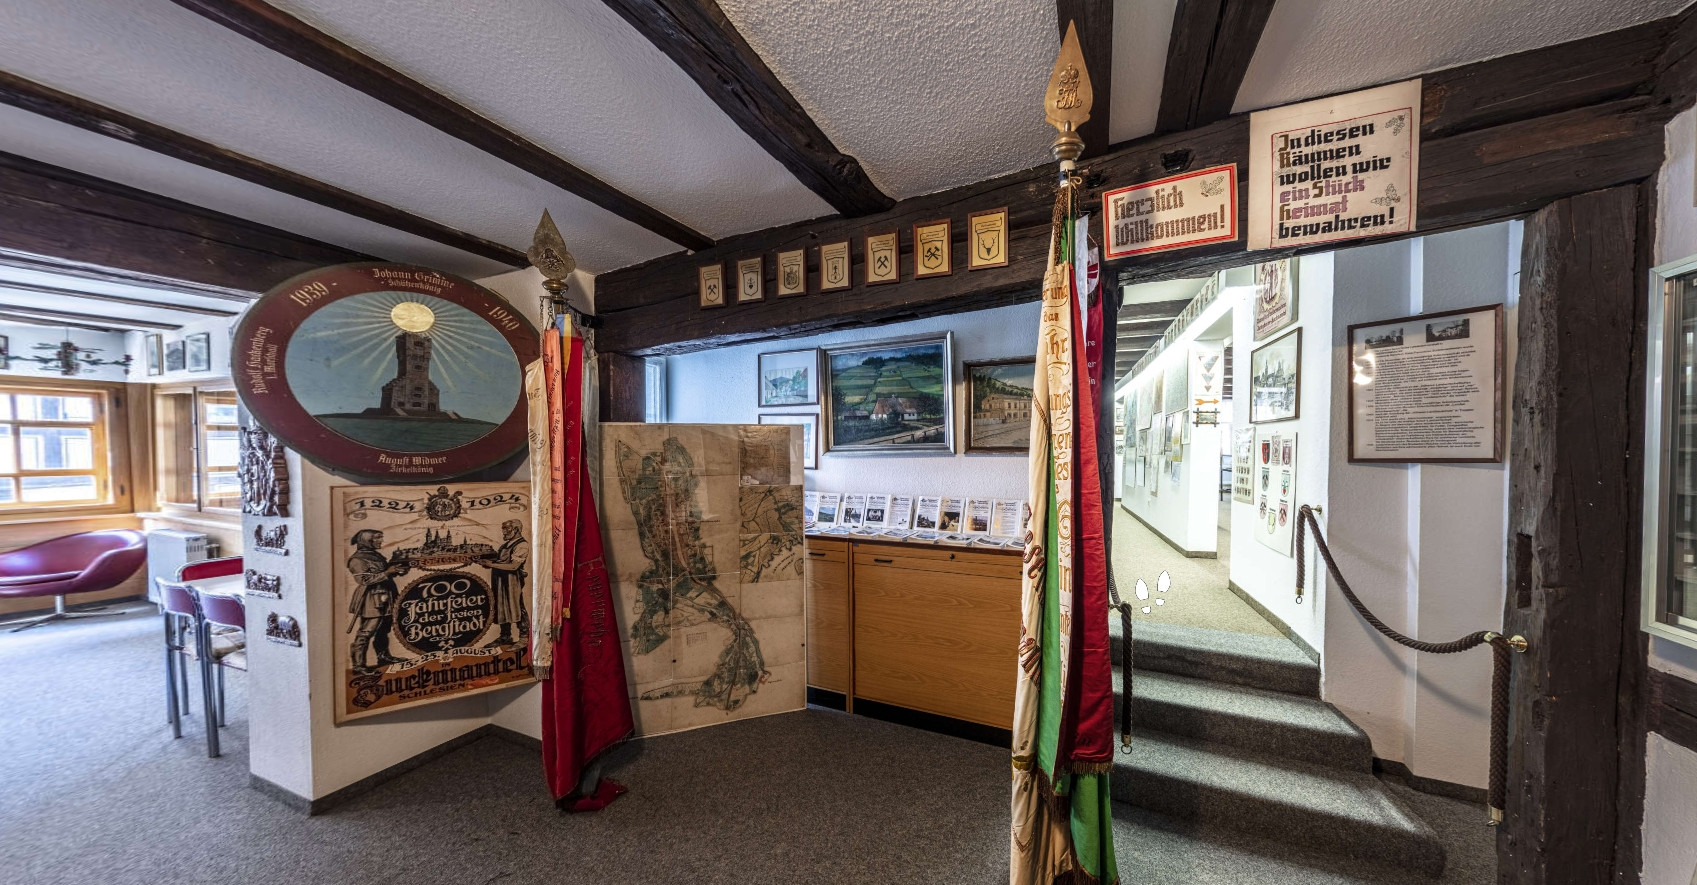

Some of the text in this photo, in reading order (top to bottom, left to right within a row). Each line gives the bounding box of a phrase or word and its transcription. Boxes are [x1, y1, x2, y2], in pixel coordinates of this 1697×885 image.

[1304, 123, 1375, 148] diesen
[1279, 144, 1362, 169] Räumen
[1278, 155, 1392, 186] wollen wir
[1279, 175, 1365, 203] ein Stück
[1112, 185, 1185, 221] Herzlich
[1114, 204, 1226, 247] Willkommen!
[1278, 206, 1395, 240] bewahren!
[372, 268, 411, 279] Johann
[289, 281, 330, 307] 1939
[487, 306, 520, 331] 1940
[354, 498, 416, 511] 1224
[418, 579, 471, 598] 700
[401, 594, 486, 625] Jahrfeier
[419, 608, 482, 623] der freien
[405, 615, 486, 643] Bergstadt
[452, 648, 493, 656] AUGUST
[398, 682, 466, 700] SCHLESIEN
